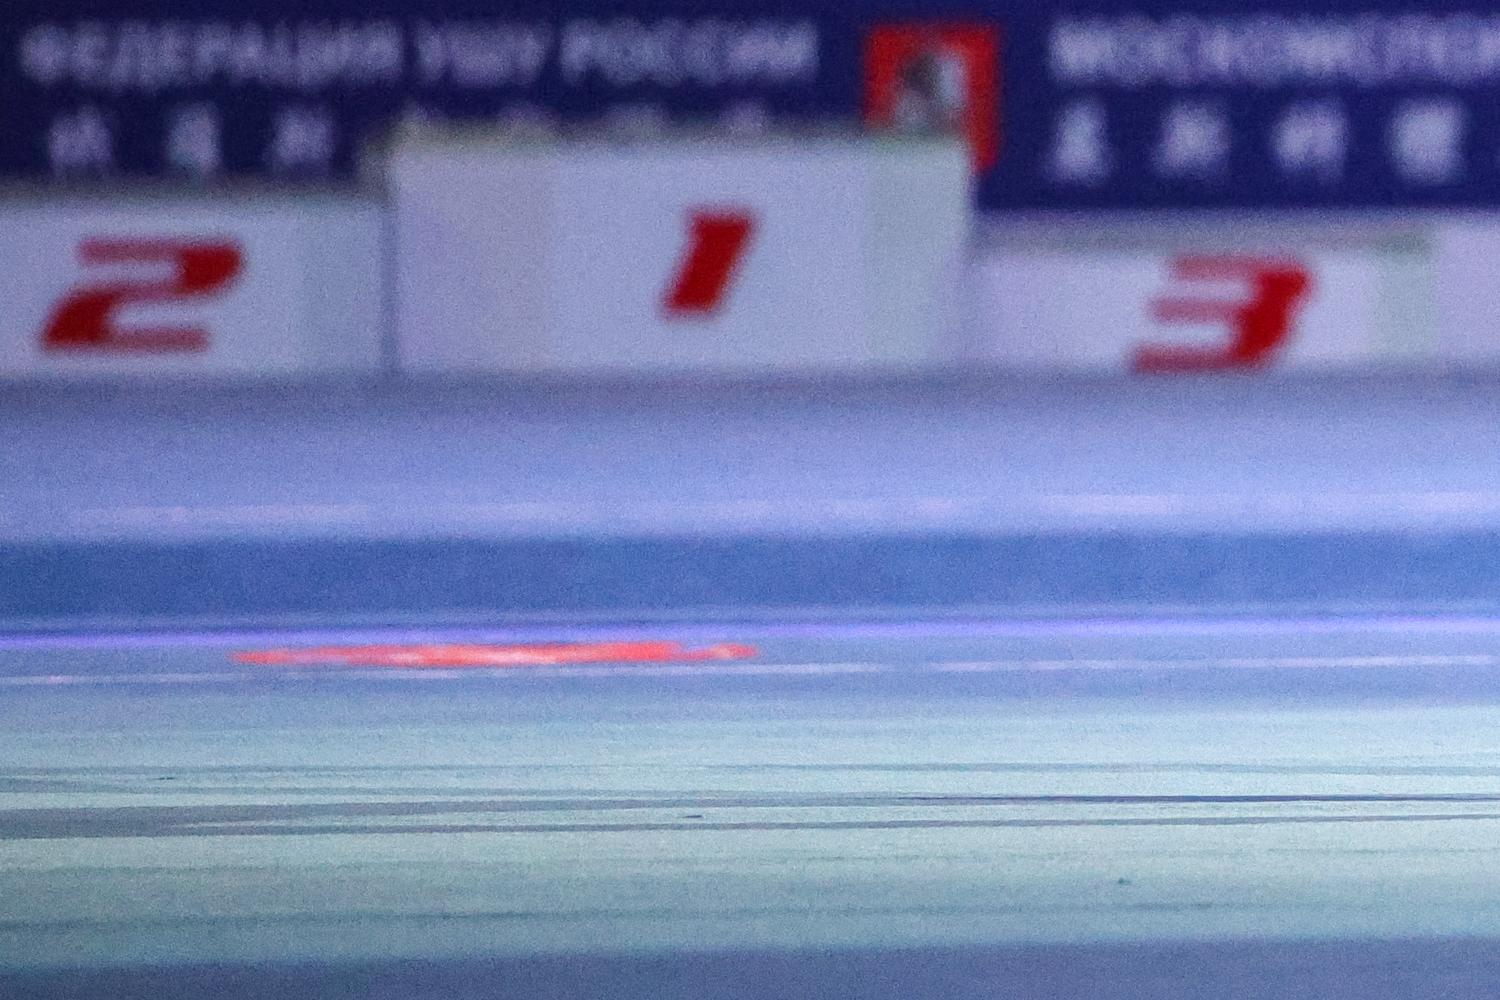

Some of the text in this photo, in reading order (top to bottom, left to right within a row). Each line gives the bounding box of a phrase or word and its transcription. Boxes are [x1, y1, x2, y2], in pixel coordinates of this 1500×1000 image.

[19, 21, 818, 89] ФЕДЕРАЦИЯ УШУ РОССИИ
[42, 238, 243, 351] 2
[662, 207, 757, 319] 1
[1132, 256, 1313, 372] 3
